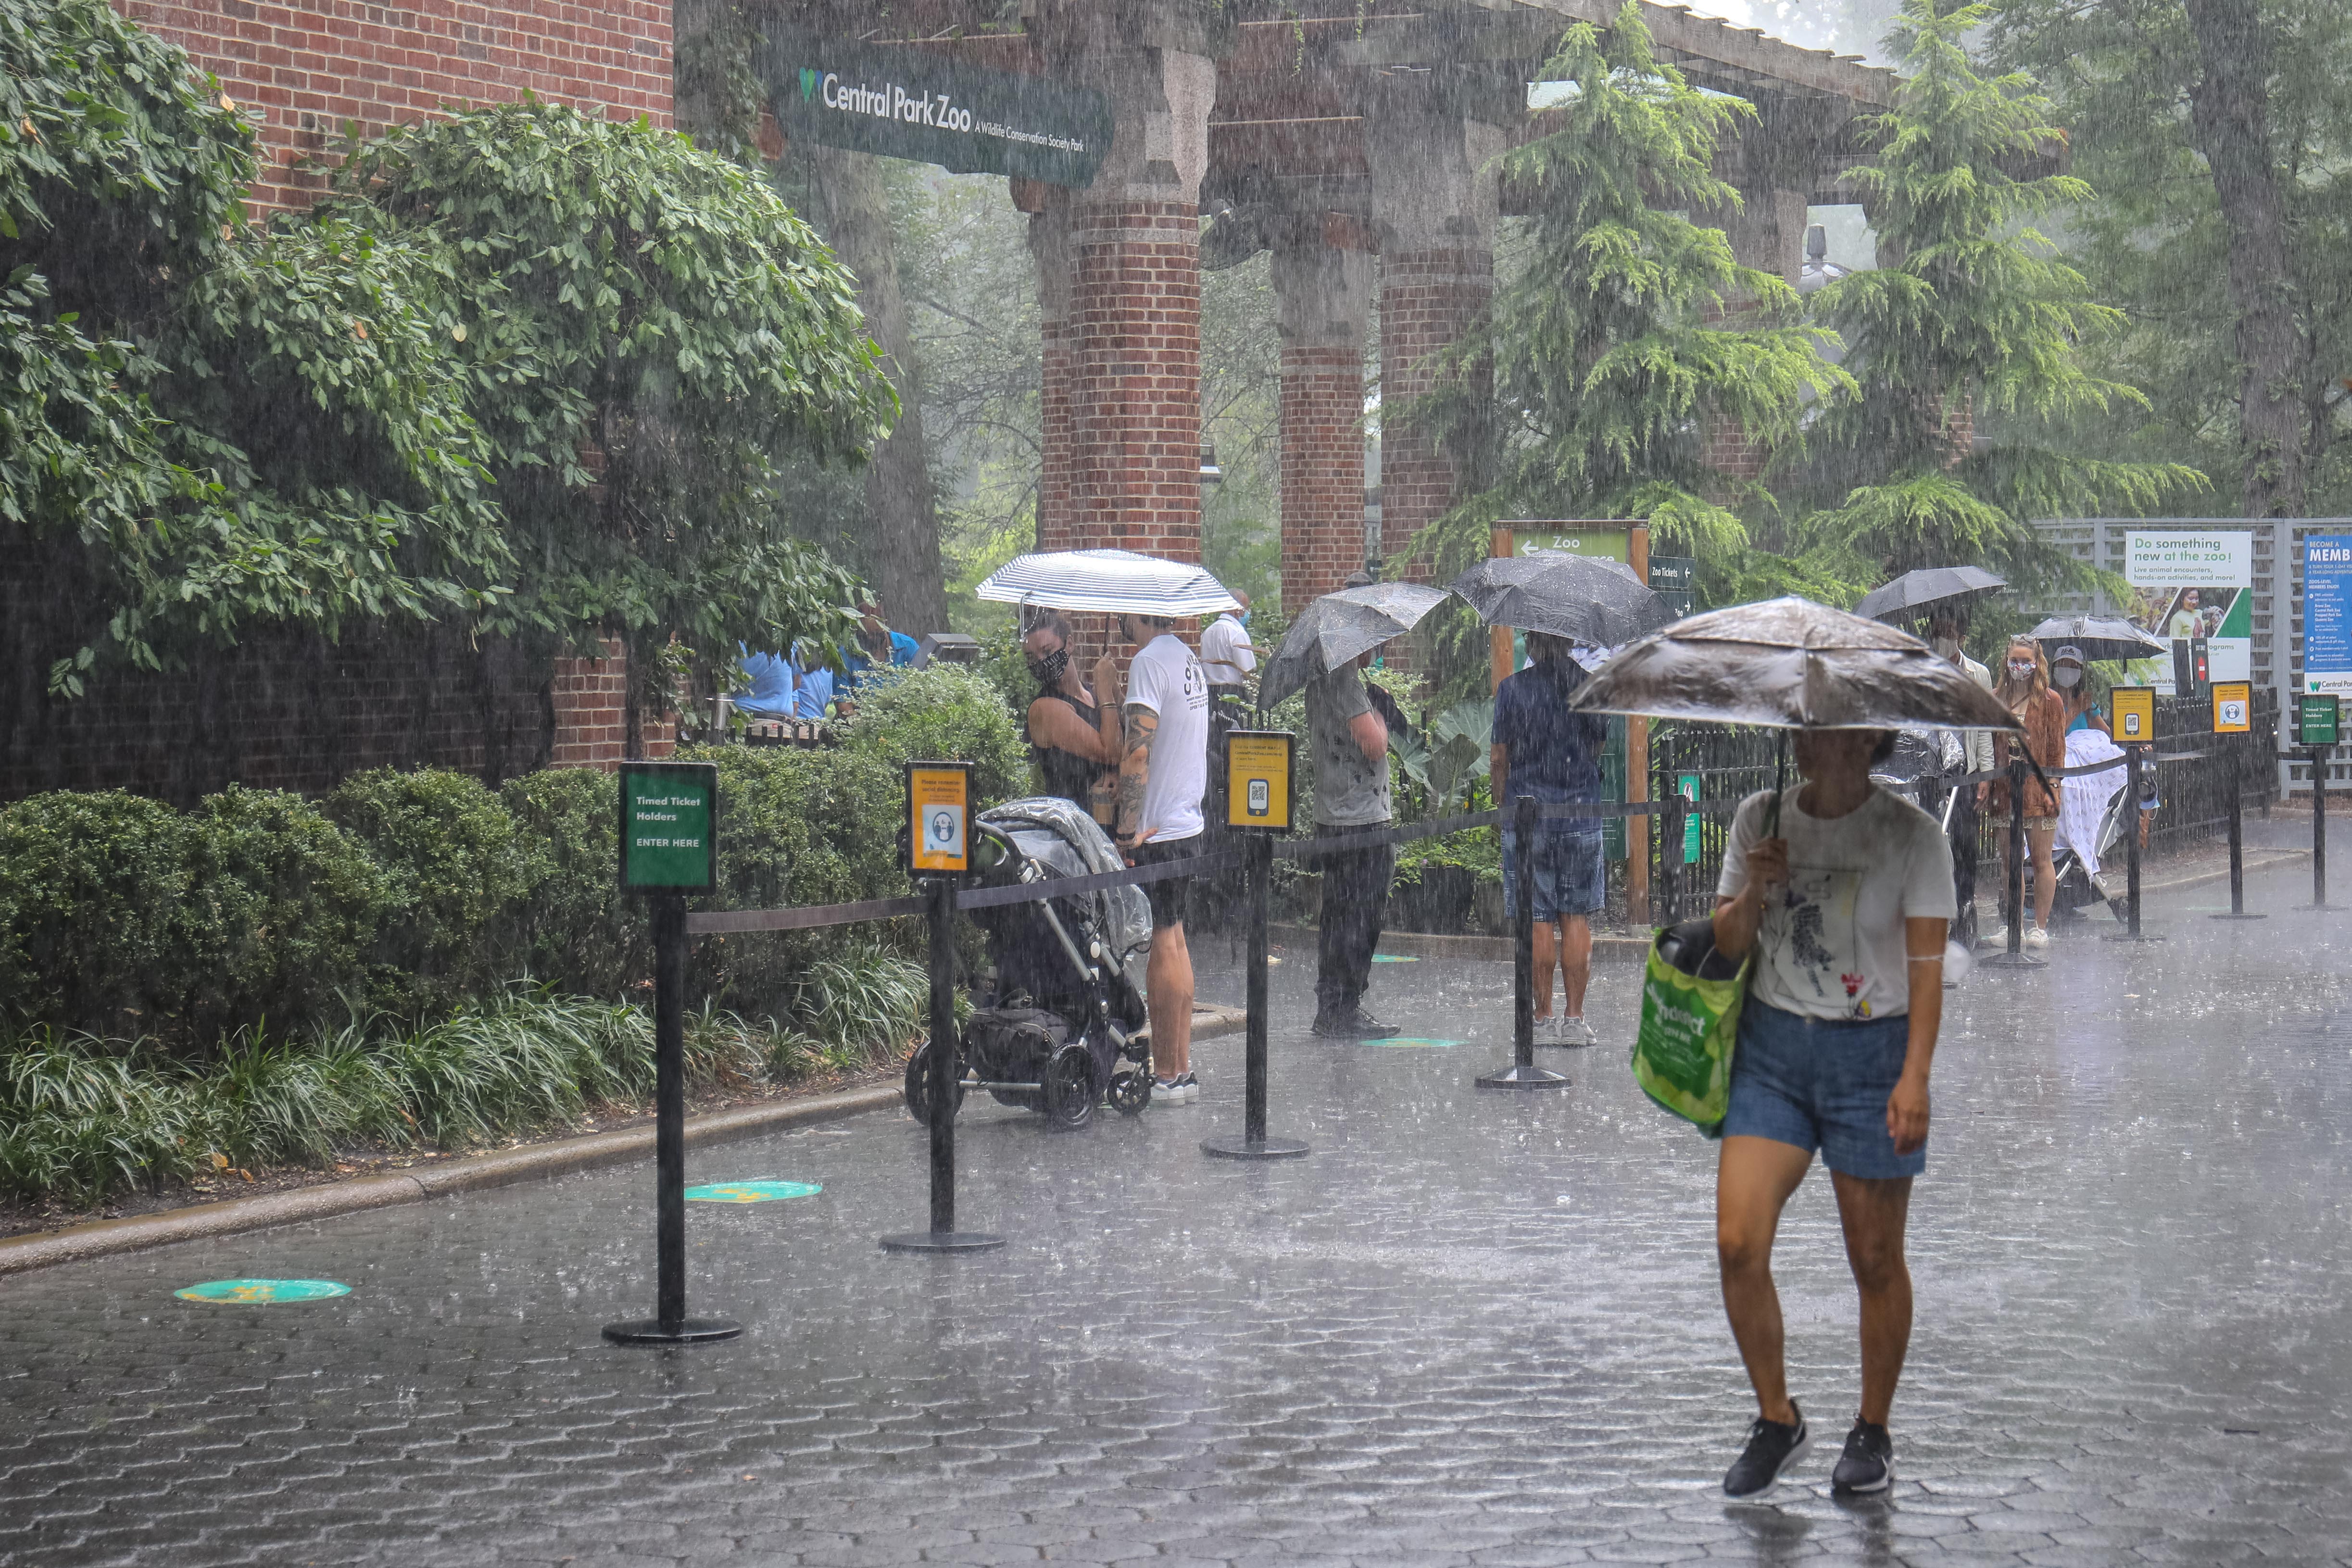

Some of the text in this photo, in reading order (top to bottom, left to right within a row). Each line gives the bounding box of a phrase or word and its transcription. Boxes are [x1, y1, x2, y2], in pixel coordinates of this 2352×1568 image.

[823, 73, 971, 132] Central Park Zoo
[974, 121, 1084, 152] A Wildlife Conservation Society Park
[1553, 536, 1580, 549] Zoo
[2135, 537, 2221, 552] Do something
[2134, 550, 2231, 563] new at the zoo!
[2310, 549, 2352, 561] MEMB
[1652, 566, 1678, 577] Zoo Tickets
[636, 796, 701, 806] Timed Ticket
[636, 812, 677, 821] Holders
[636, 838, 699, 848] ENTER HERE
